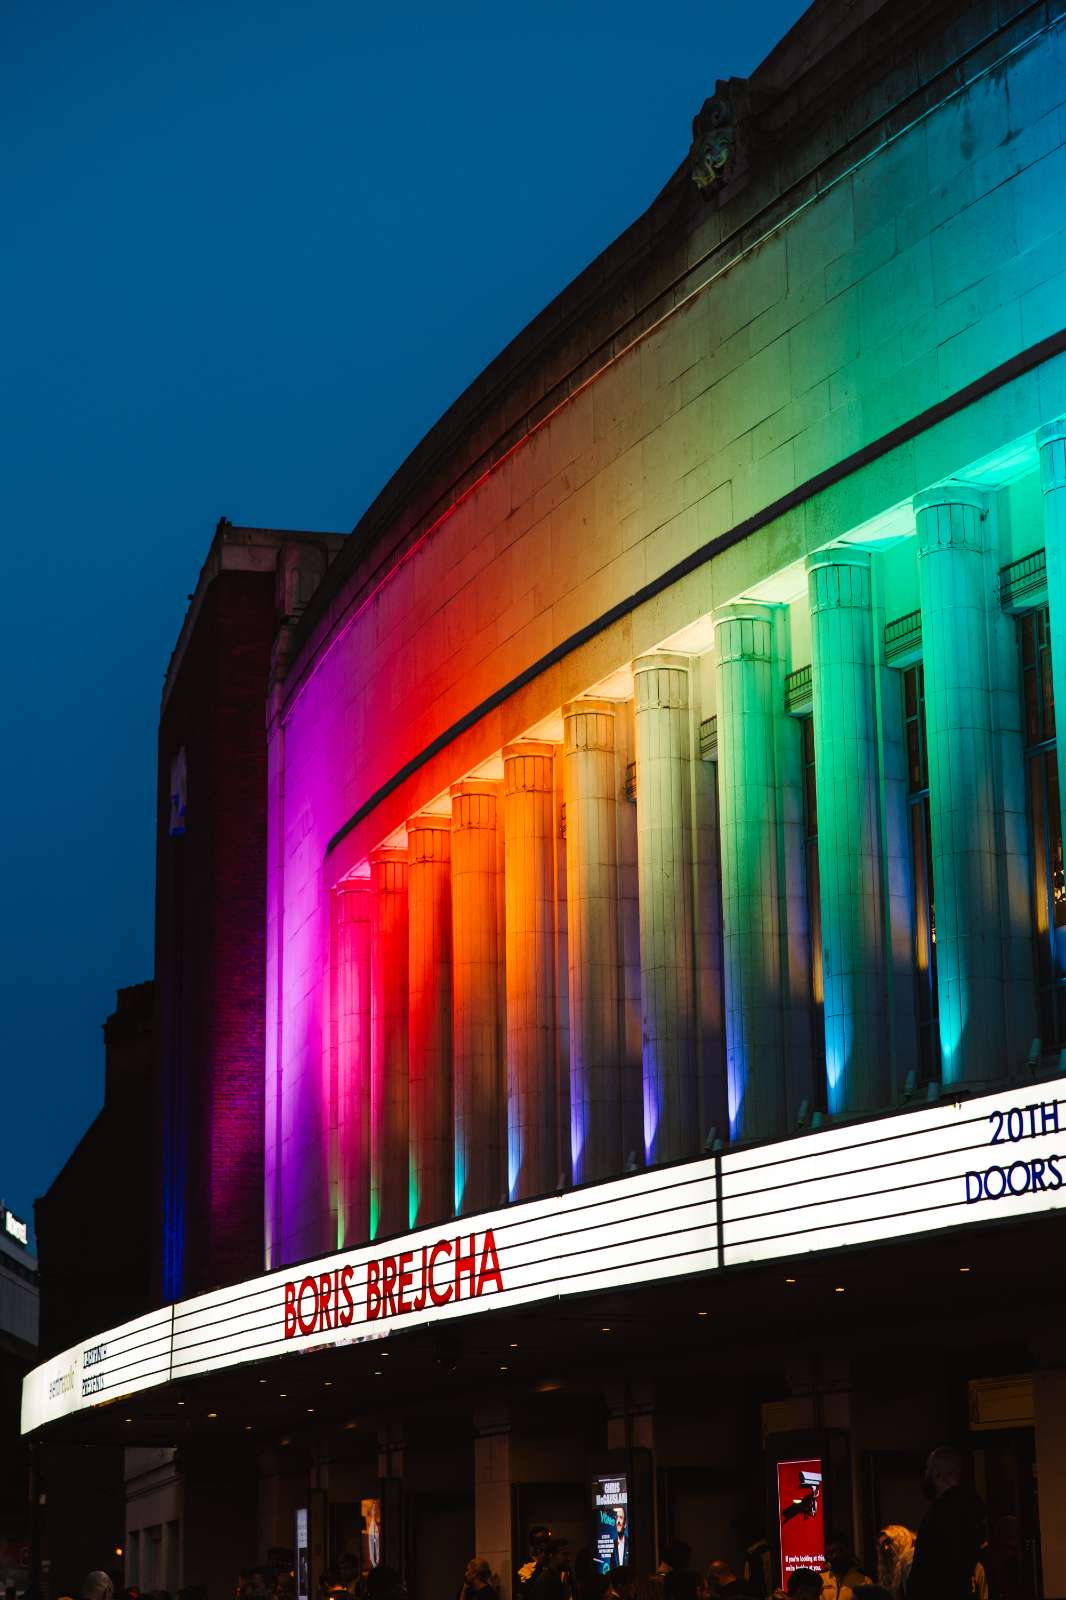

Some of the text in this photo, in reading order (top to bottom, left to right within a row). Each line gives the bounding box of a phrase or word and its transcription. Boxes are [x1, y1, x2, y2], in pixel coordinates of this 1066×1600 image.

[989, 1099, 1059, 1145] 20TH
[965, 1154, 1063, 1205] DOORS
[284, 1228, 504, 1339] BORIS BREJCHA
[799, 1554, 812, 1563] looking
